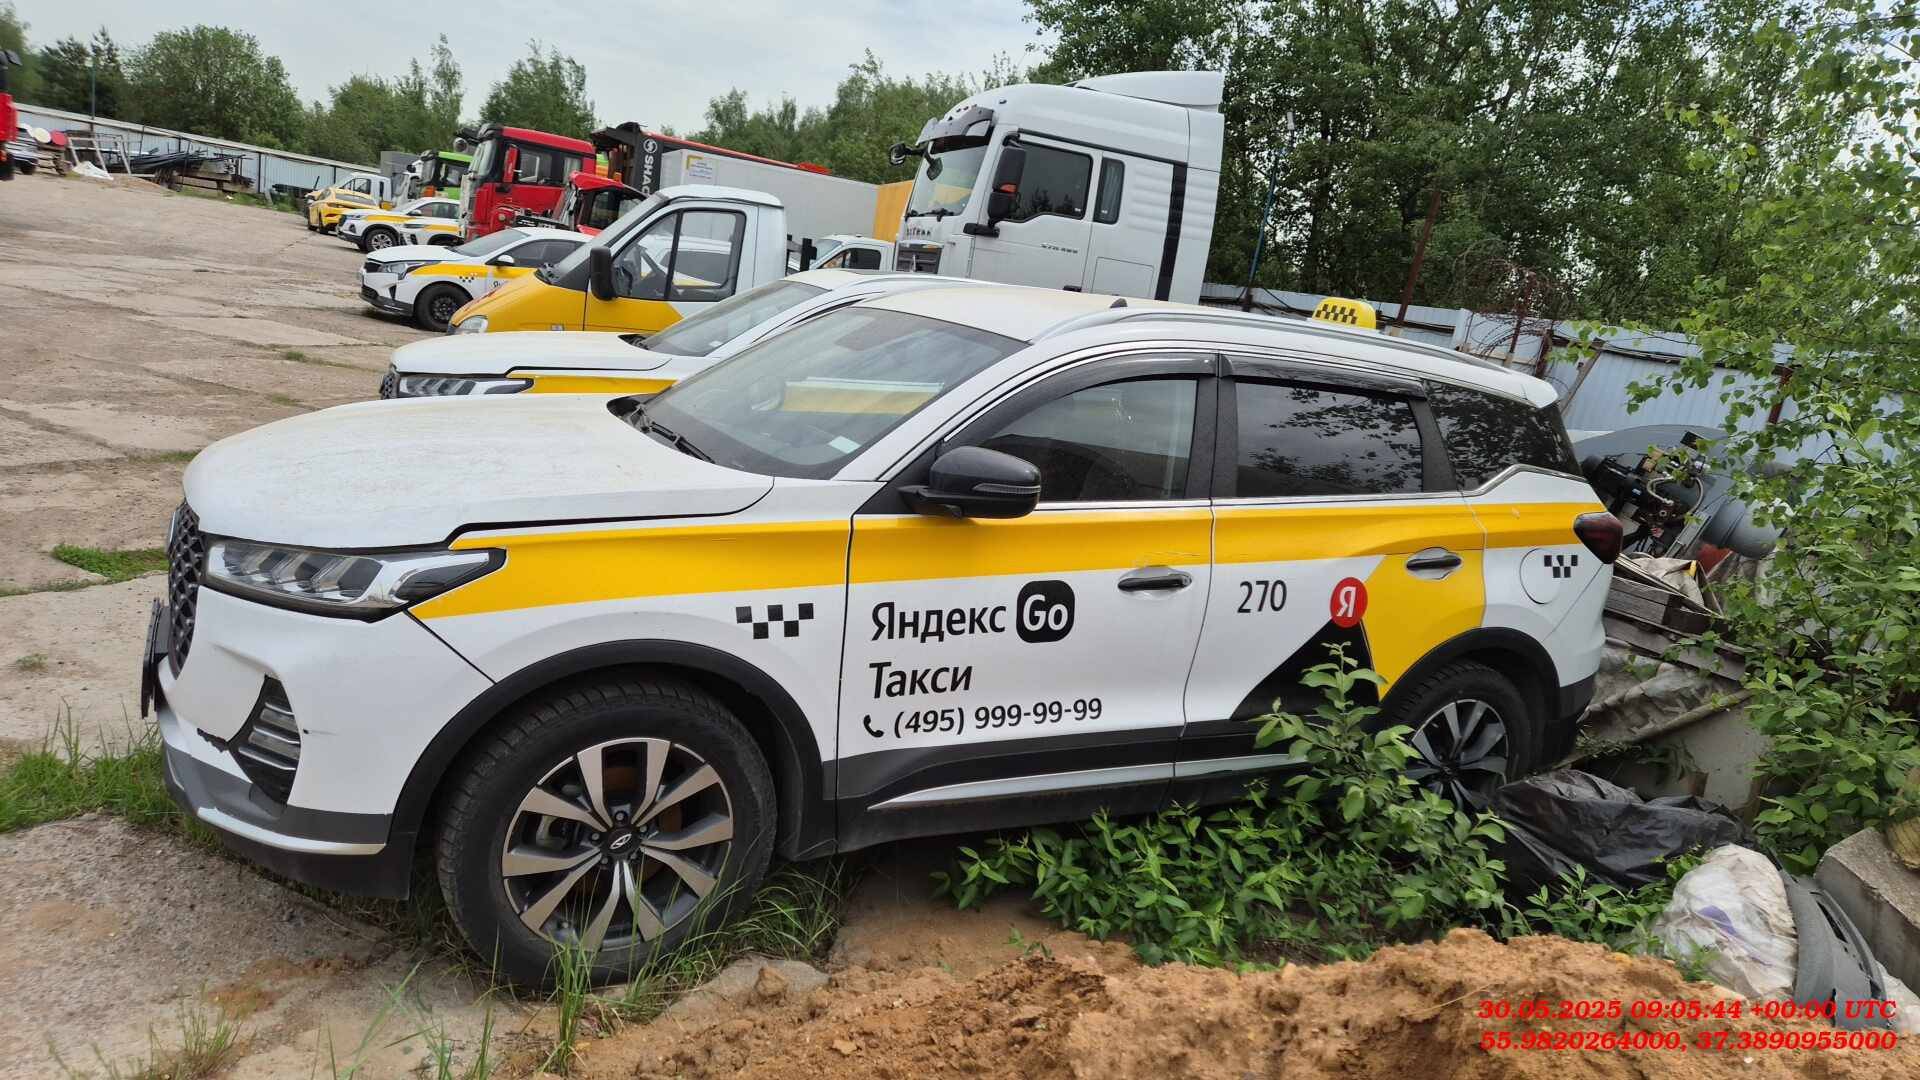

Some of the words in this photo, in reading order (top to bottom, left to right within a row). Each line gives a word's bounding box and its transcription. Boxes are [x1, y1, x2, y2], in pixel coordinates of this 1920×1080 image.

[1237, 580, 1287, 614] 270
[1336, 585, 1356, 618] Я
[871, 601, 1007, 643] Яндекс
[1022, 593, 1069, 632] Go
[869, 661, 973, 699] Такси
[894, 706, 964, 739] (495)
[974, 697, 1102, 730] 999-99-99
